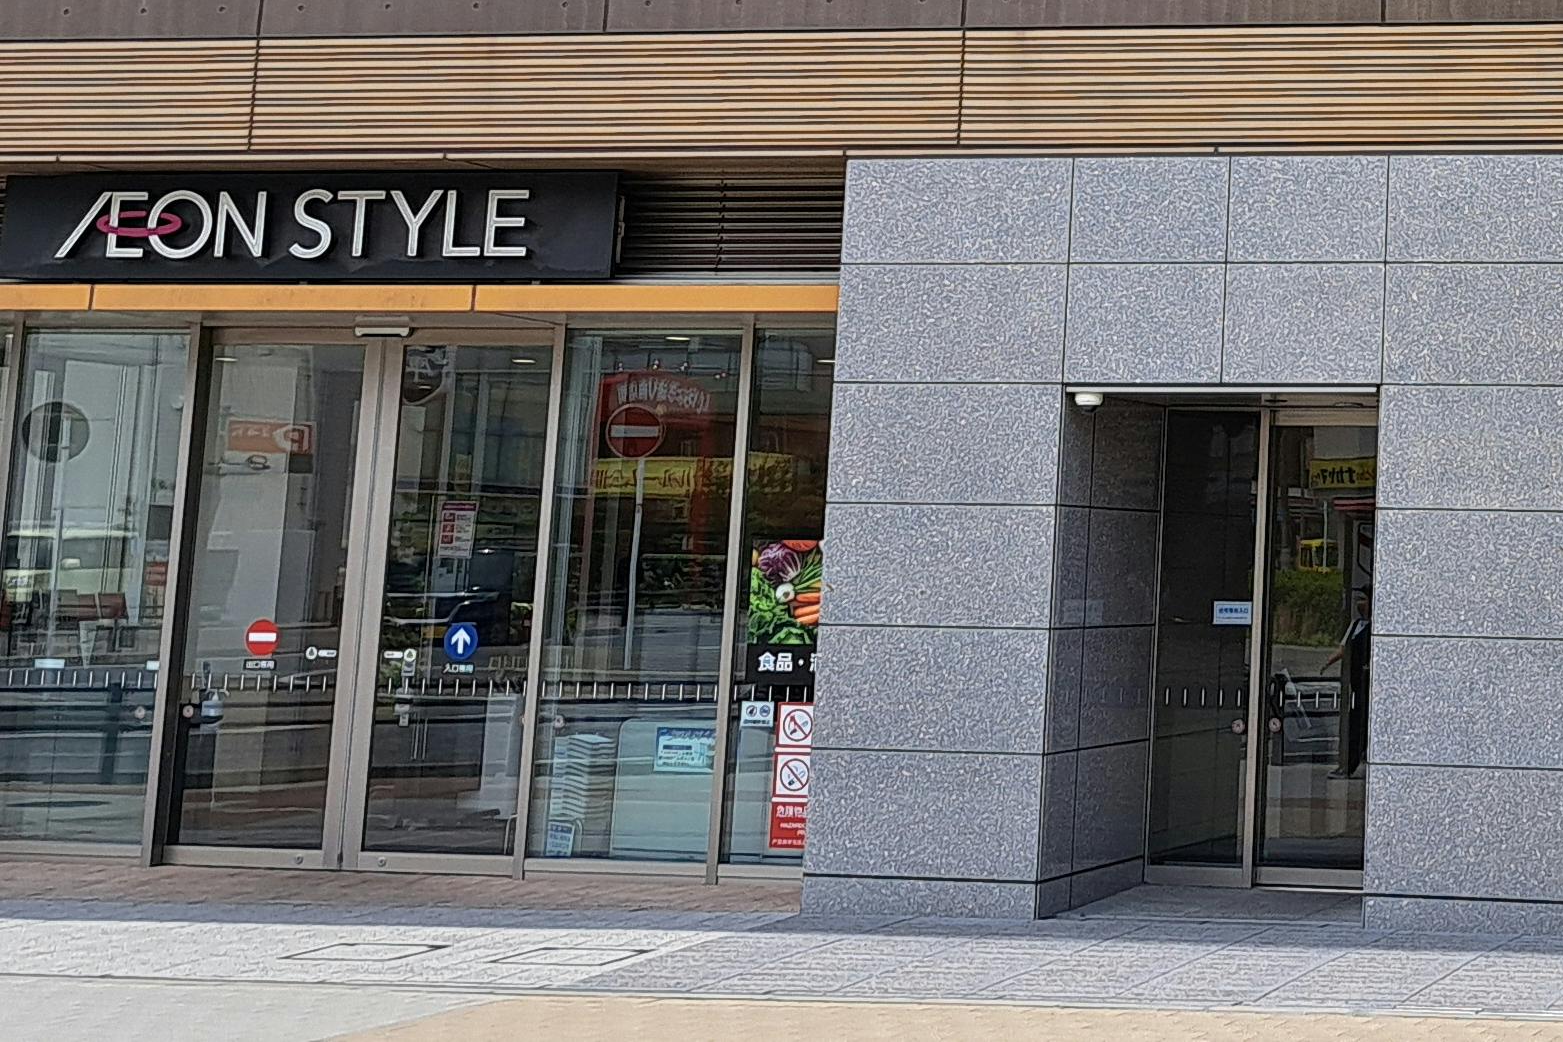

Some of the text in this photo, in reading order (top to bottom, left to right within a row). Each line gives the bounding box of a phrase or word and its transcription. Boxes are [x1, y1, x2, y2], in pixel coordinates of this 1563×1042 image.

[288, 188, 530, 259] STYLE
[757, 651, 817, 672] 食品・
